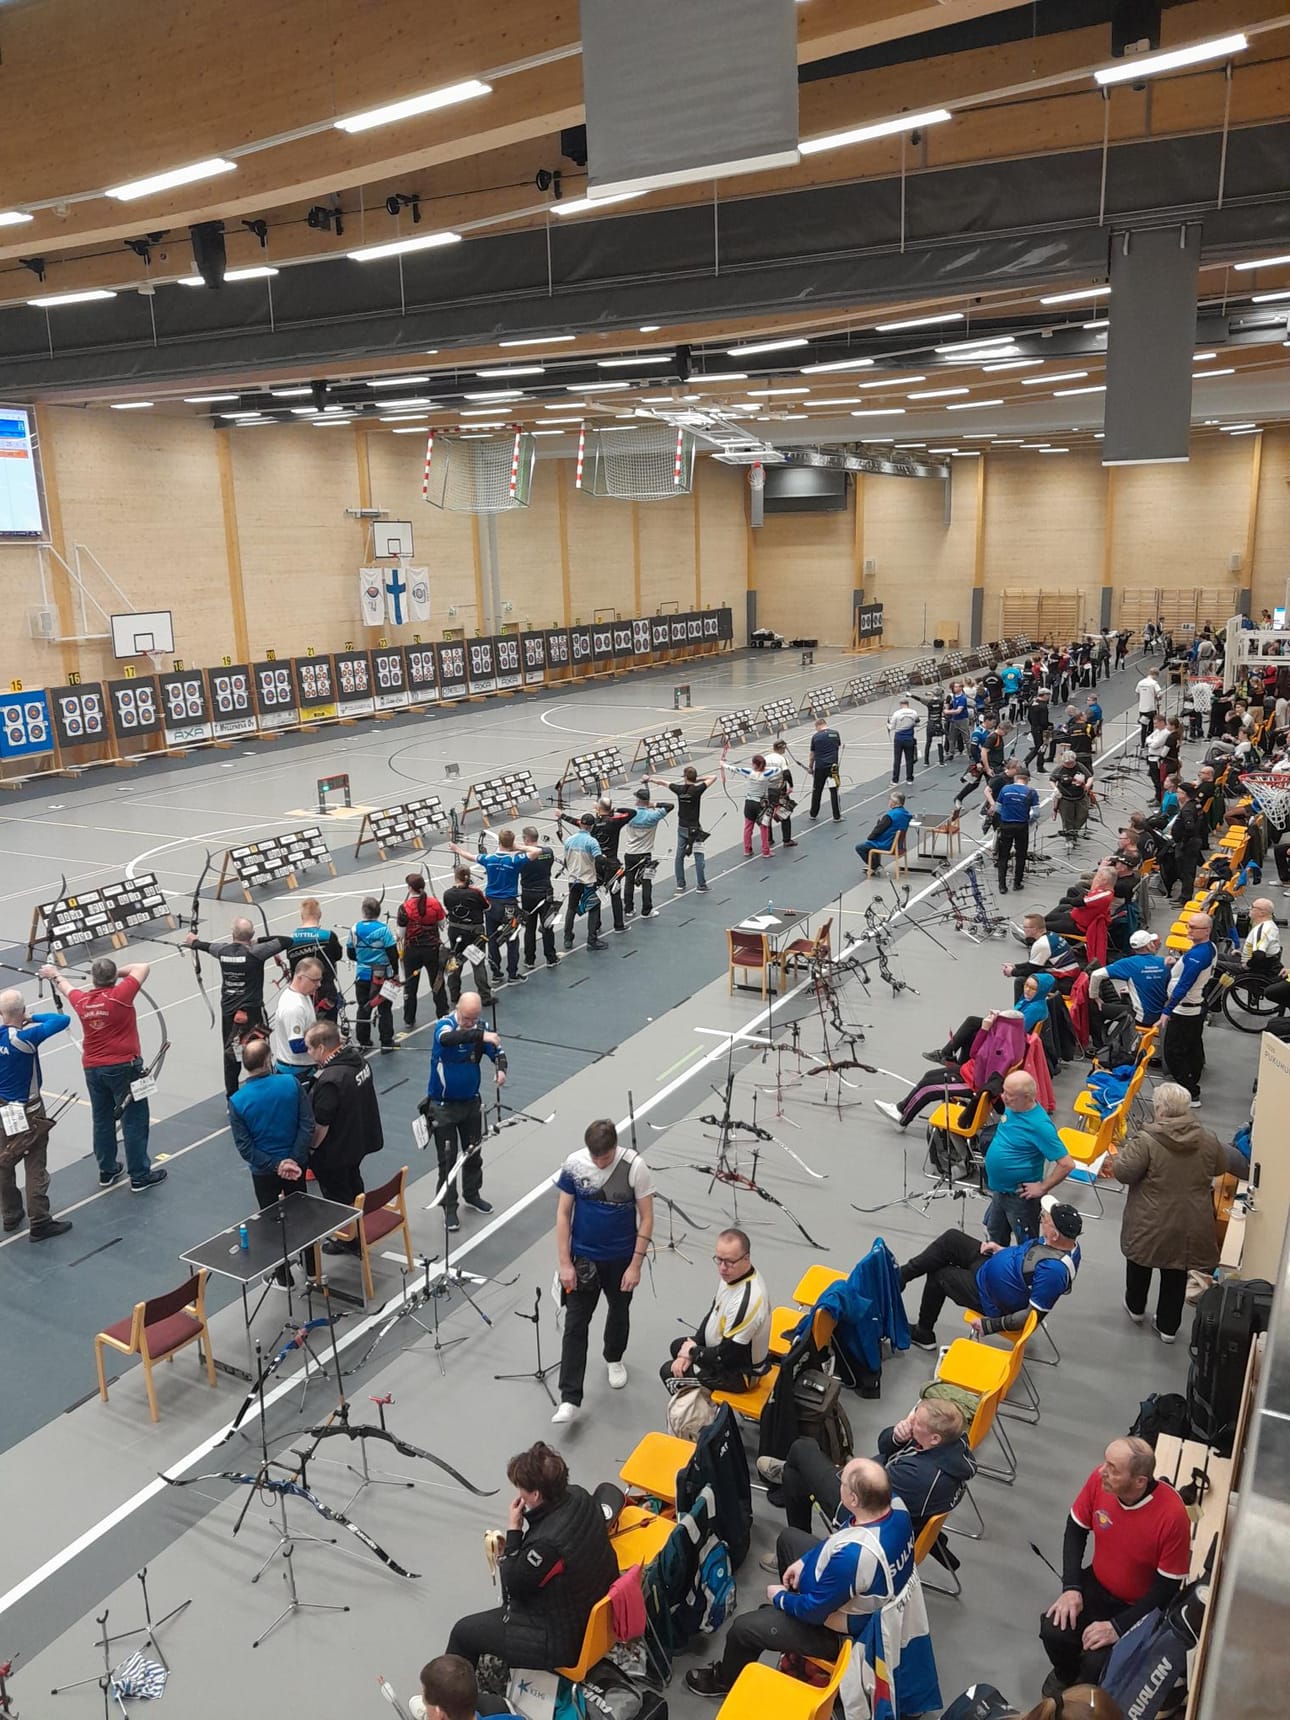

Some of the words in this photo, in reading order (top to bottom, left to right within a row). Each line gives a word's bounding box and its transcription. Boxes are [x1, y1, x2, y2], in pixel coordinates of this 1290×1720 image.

[173, 661, 184, 671] 18
[222, 656, 231, 666] 19
[125, 667, 135, 677] 17
[68, 674, 81, 685] 16
[11, 680, 23, 691] 15
[174, 727, 204, 740] AXA
[1128, 1656, 1173, 1720] AVALON
[583, 1687, 613, 1714] AVA
